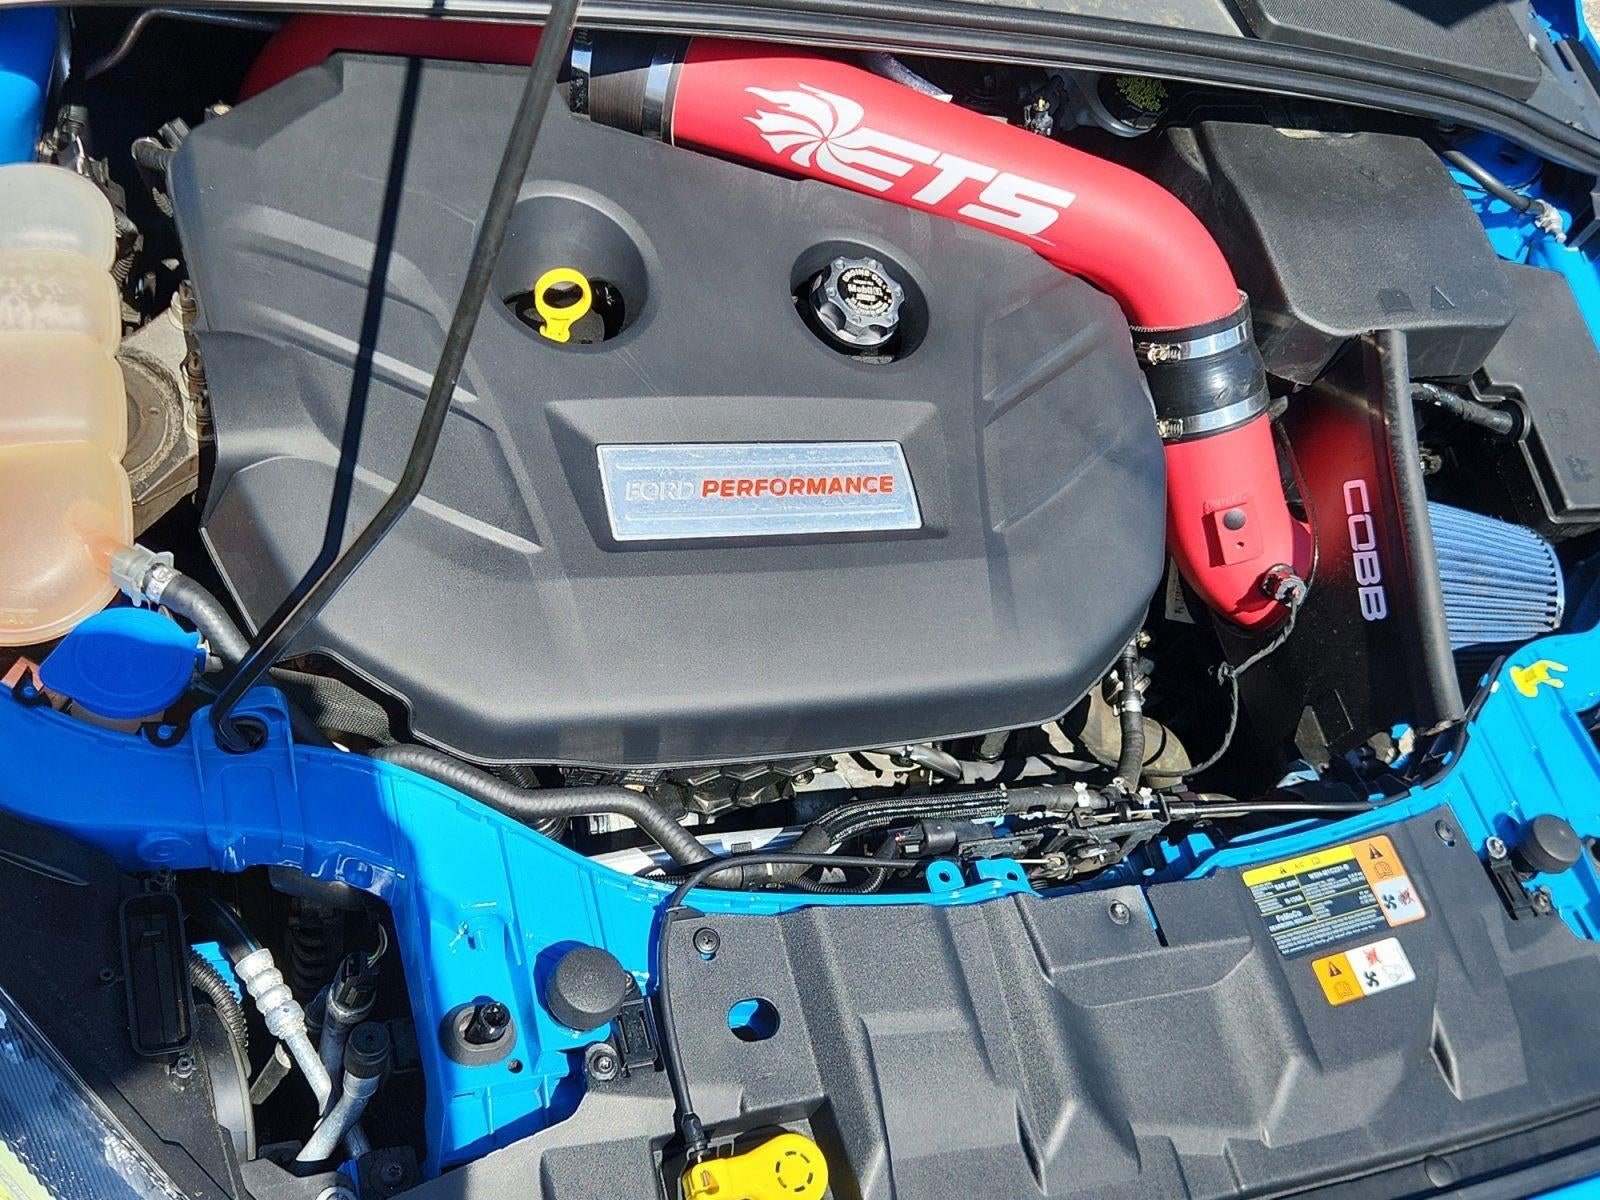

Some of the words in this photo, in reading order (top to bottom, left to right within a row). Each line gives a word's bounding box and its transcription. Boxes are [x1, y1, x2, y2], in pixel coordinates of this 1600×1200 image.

[816, 124, 1077, 237] ETS
[625, 479, 695, 501] FORD
[701, 475, 895, 499] PERFORMANCE
[1343, 479, 1387, 621] COBB
